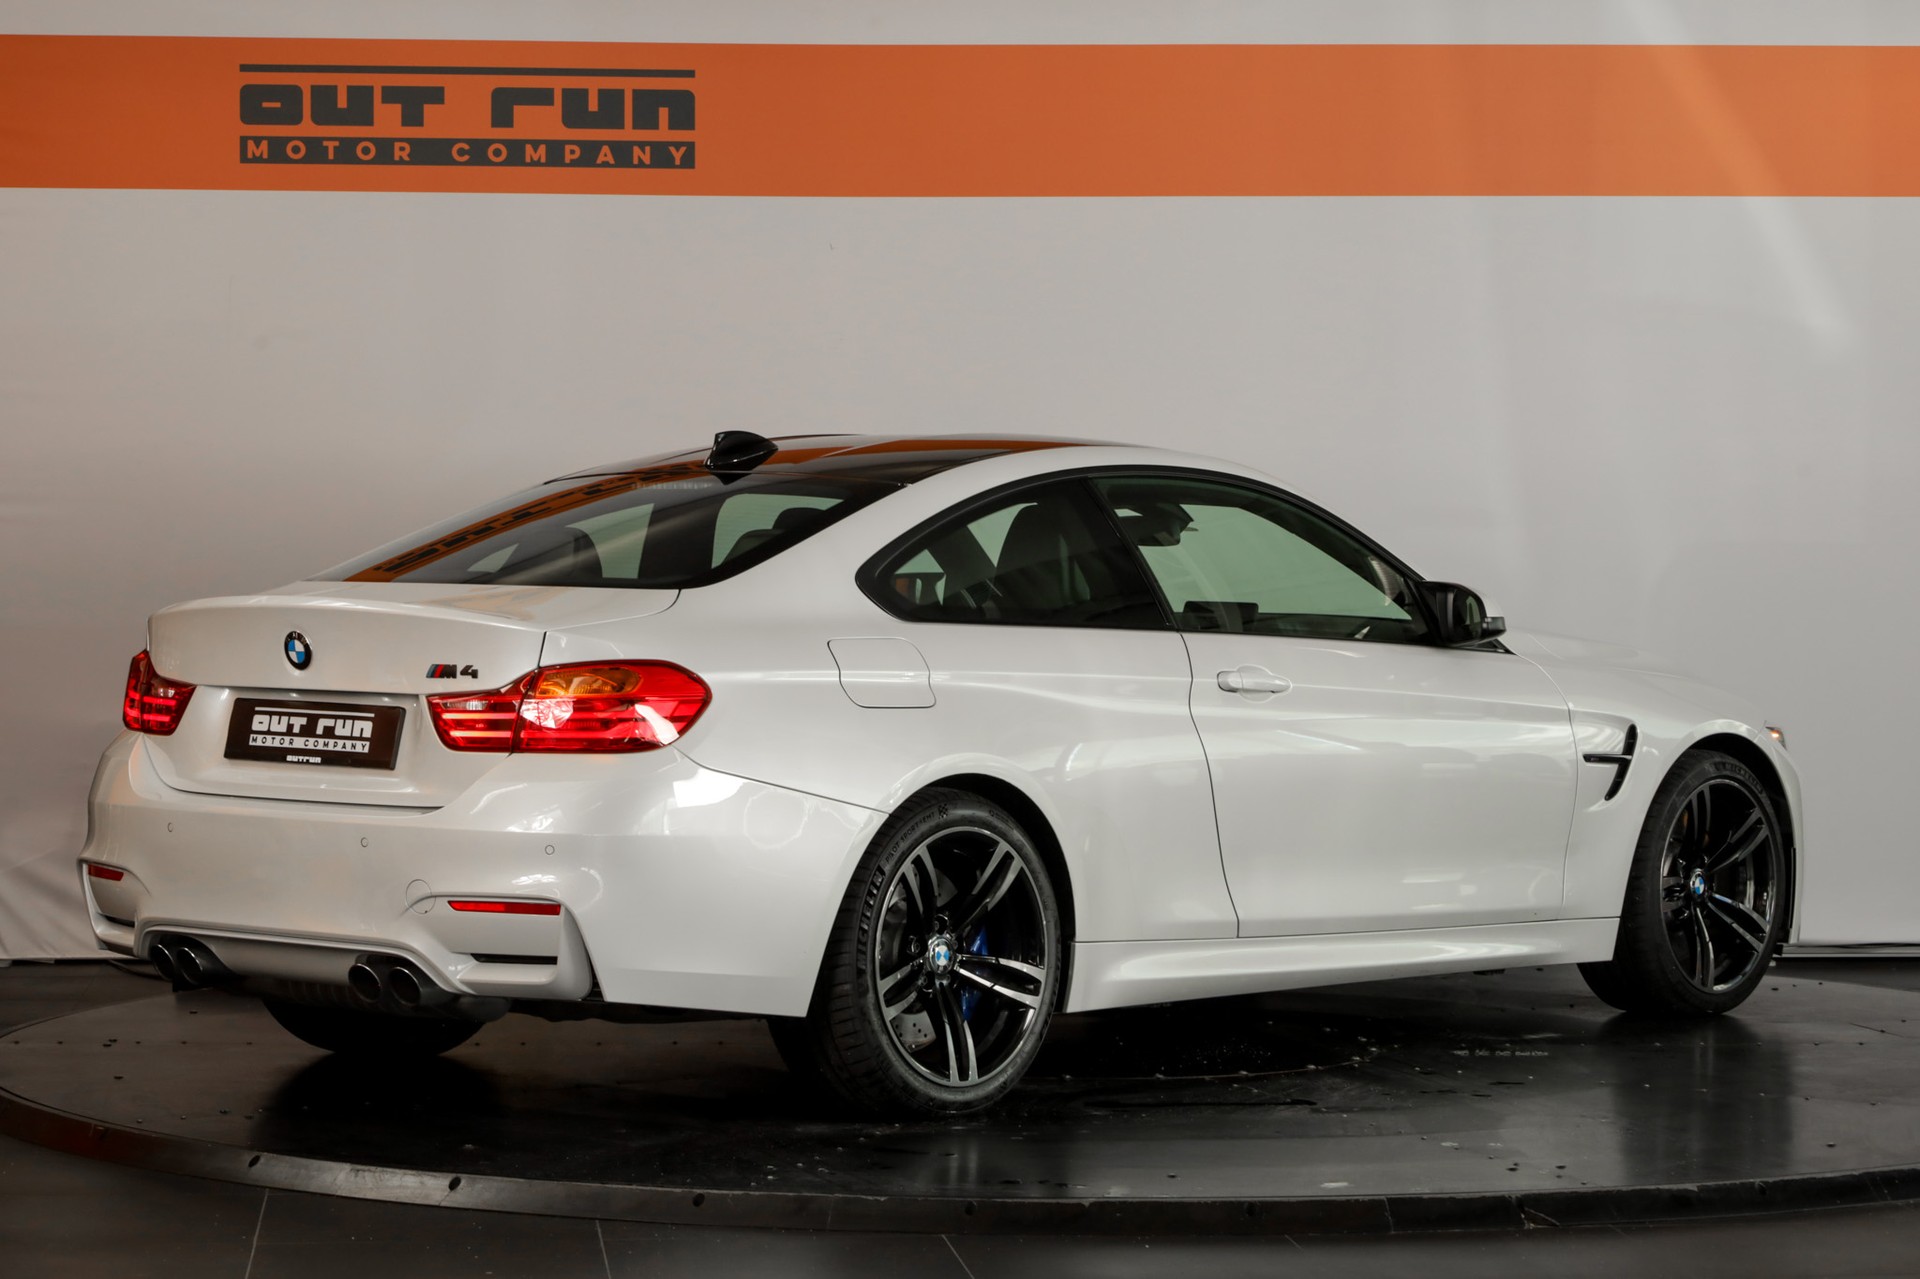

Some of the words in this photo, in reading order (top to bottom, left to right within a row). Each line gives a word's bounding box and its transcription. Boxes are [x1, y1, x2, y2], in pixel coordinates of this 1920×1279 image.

[247, 139, 411, 162] MOTOR
[451, 142, 688, 166] COMPANY
[426, 663, 479, 679] M4
[250, 735, 295, 747] MOTOR
[303, 739, 367, 752] COMPANY
[857, 867, 885, 972] MICHELIN
